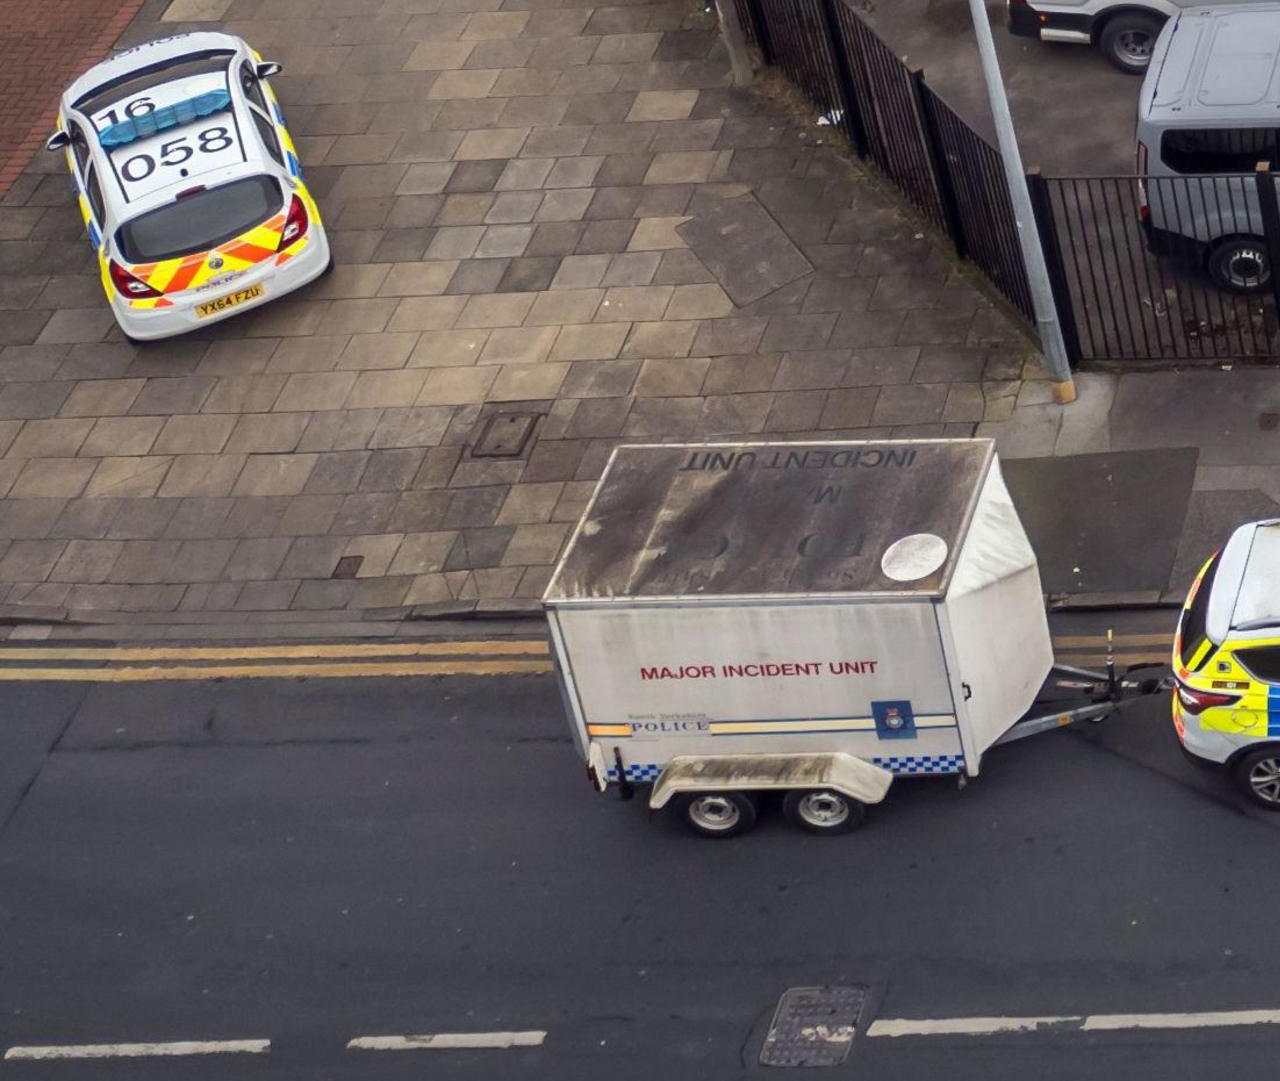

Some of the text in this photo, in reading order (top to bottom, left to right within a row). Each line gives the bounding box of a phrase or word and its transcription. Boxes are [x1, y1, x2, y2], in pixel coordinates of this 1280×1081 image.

[98, 96, 156, 125] 16
[121, 126, 234, 183] 058
[678, 450, 917, 471] INCIDENT UNIT
[640, 660, 878, 680] MAJOR INCIDENT UNIT
[632, 721, 709, 733] POLICE
